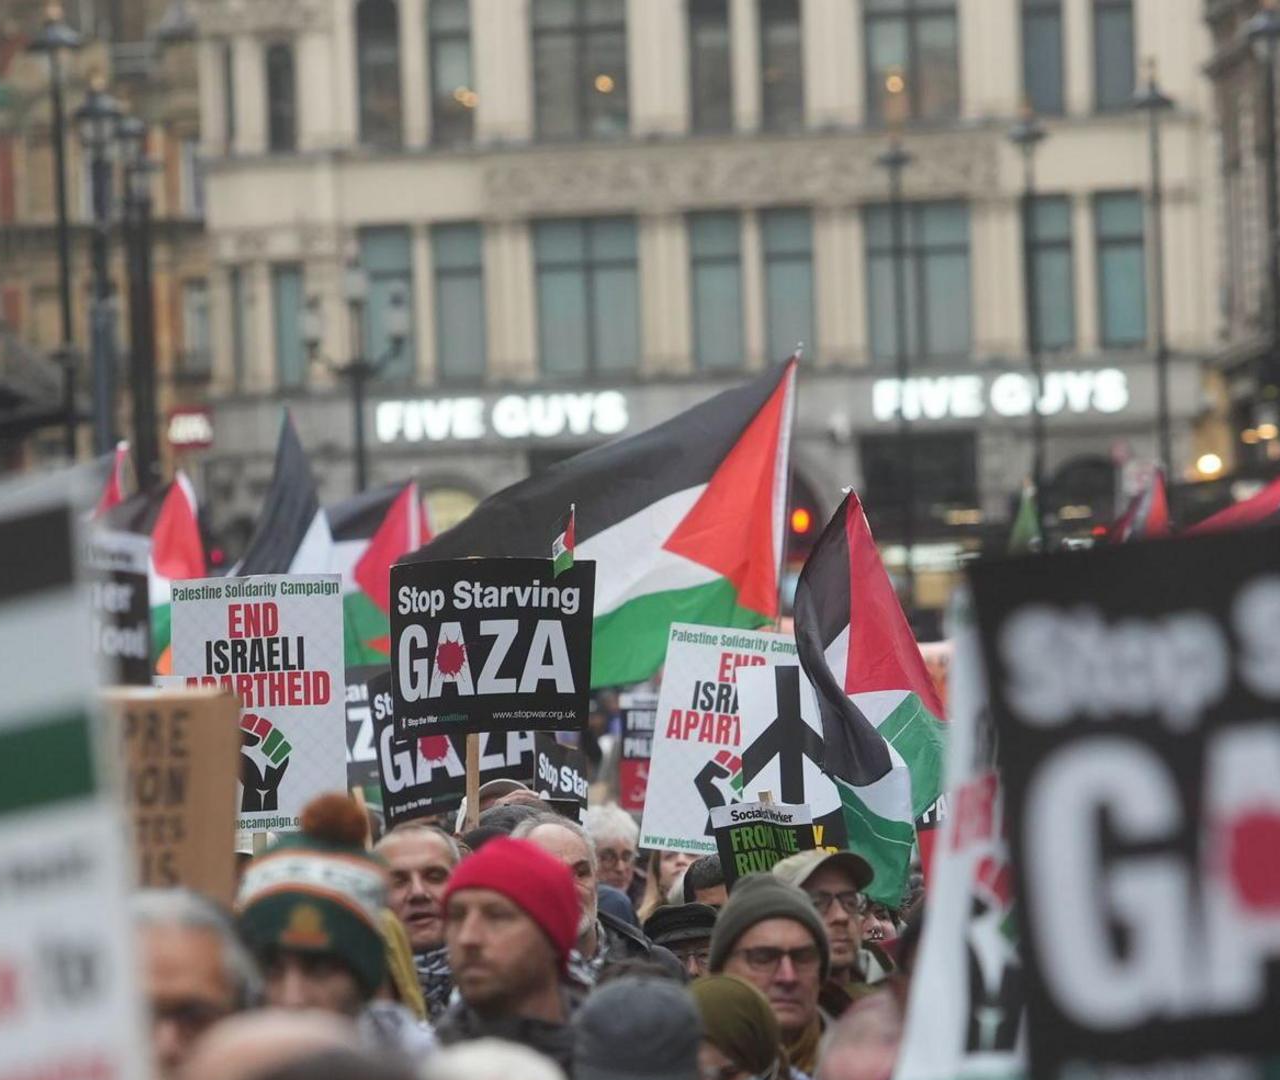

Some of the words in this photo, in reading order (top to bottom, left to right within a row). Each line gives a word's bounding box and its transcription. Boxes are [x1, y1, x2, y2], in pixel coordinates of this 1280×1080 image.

[872, 374, 986, 422] FIVE
[990, 368, 1129, 417] GUYS
[376, 397, 486, 442] FIVE
[492, 390, 629, 438] GUYS
[173, 585, 221, 601] Palestine
[225, 582, 276, 598] Solidarity
[280, 580, 339, 596] Campaign
[398, 585, 445, 617] Stop
[453, 579, 580, 615] Starving
[228, 602, 279, 638] END
[206, 636, 305, 675] ISRAELI
[398, 619, 576, 702] GAZA
[672, 630, 718, 646] Palestine
[720, 634, 768, 652] Solidarity
[771, 640, 798, 655] Camp
[997, 604, 1230, 731] Stop
[492, 709, 576, 721] www.stopwar.org.uk
[666, 709, 741, 746] APART
[539, 752, 558, 792] Stop
[730, 825, 774, 851] FROM
